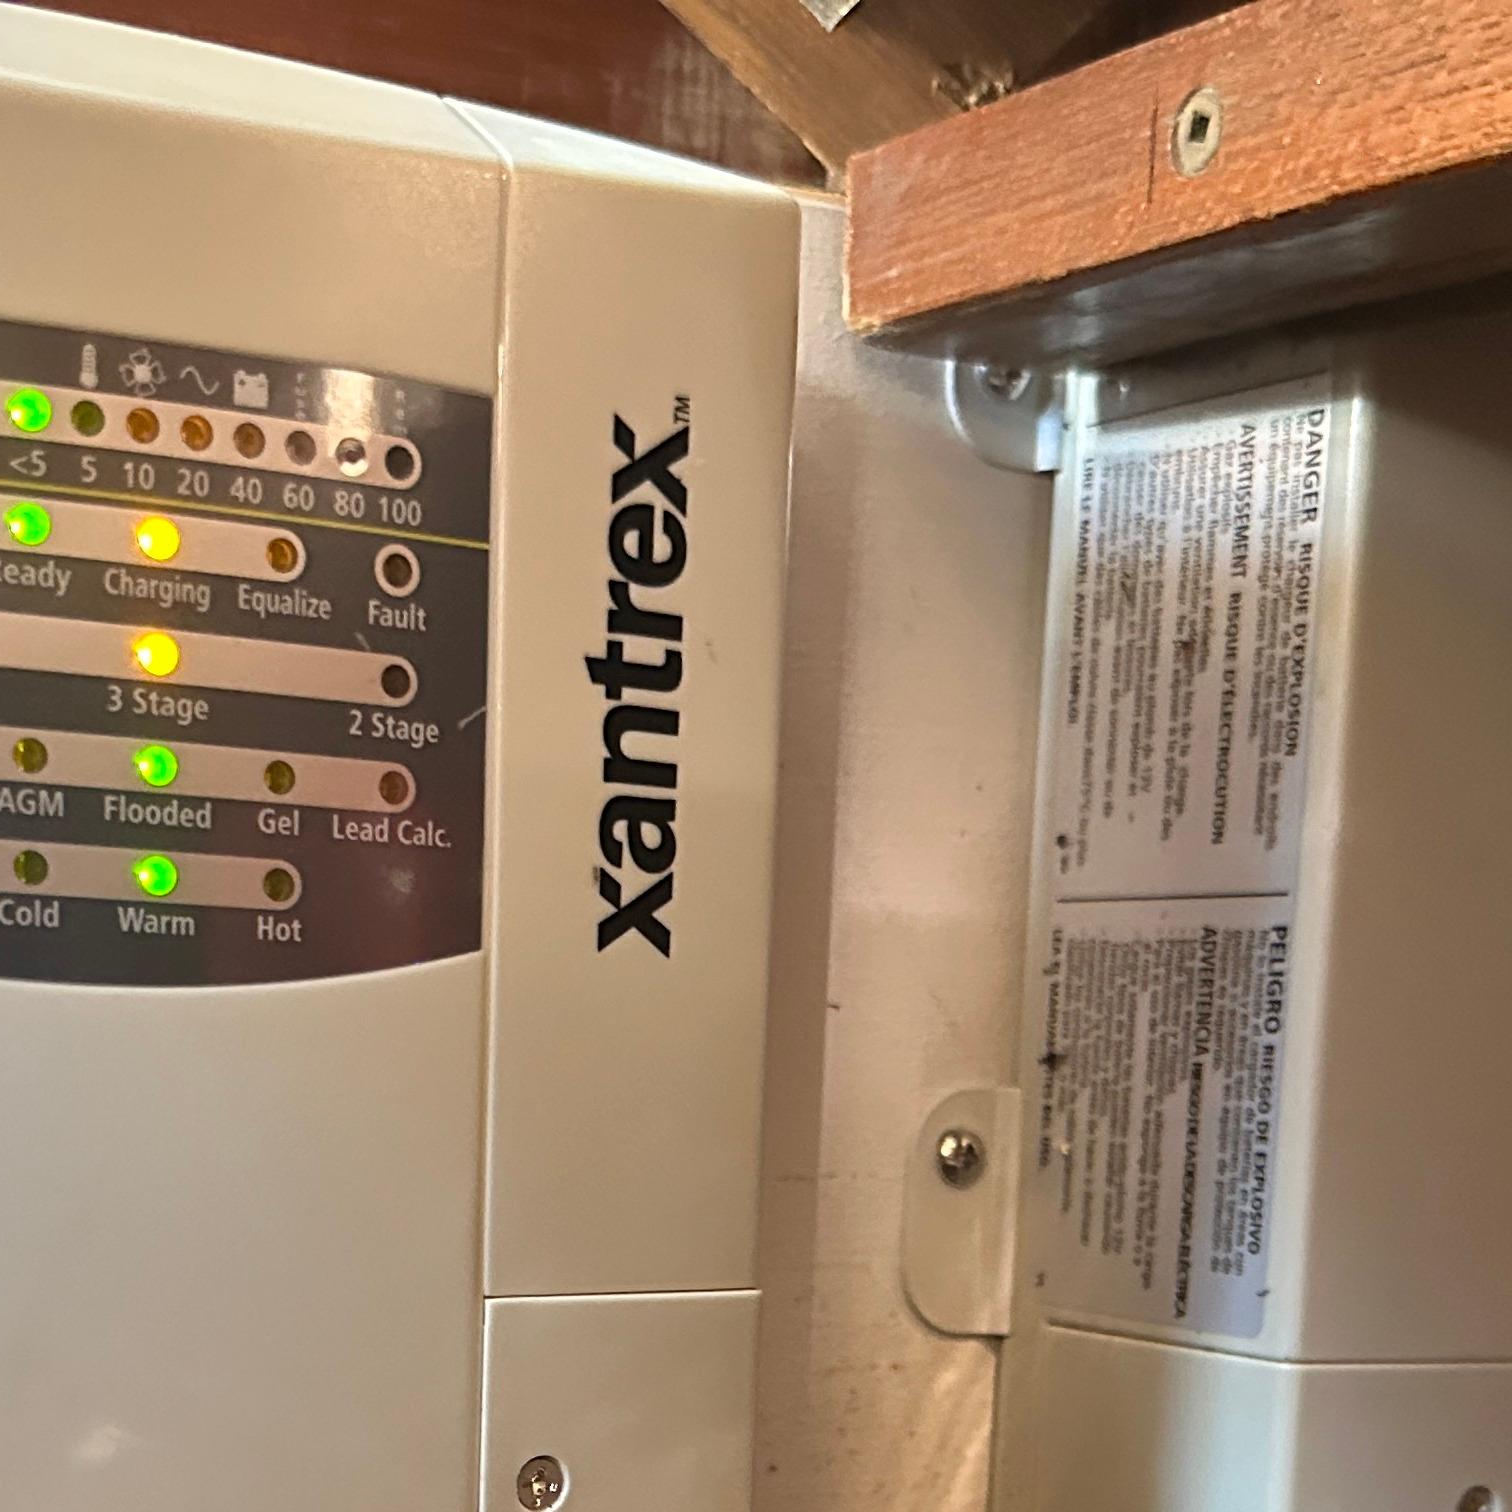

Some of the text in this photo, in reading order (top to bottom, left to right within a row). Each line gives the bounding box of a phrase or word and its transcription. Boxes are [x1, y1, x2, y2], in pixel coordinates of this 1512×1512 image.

[9, 450, 422, 526] <5 5 10 20 40 60 80 100
[1298, 407, 1325, 524] DANGER
[1229, 422, 1258, 579] AVERTISSEMENT
[104, 567, 211, 613] Charging
[1294, 542, 1313, 616] RISQUE
[238, 584, 332, 621] Equalize
[368, 601, 427, 632] Fault
[1223, 591, 1242, 661] RISQUE
[107, 686, 209, 725] 3 Stage
[585, 412, 689, 958] xantrex
[349, 709, 440, 747] 2 Stage
[104, 795, 212, 830] Flooded
[257, 808, 300, 836] Gel
[332, 815, 452, 848] Lead Calc.
[117, 907, 195, 937] Warm
[257, 915, 302, 942] Hot
[1192, 926, 1219, 1056] ADVERTENCIA
[1263, 925, 1288, 1034] PELIGRO
[1257, 1044, 1275, 1114] RIESGO
[1255, 1120, 1270, 1144] DE
[1246, 1151, 1268, 1255] EXPLOSIVO
